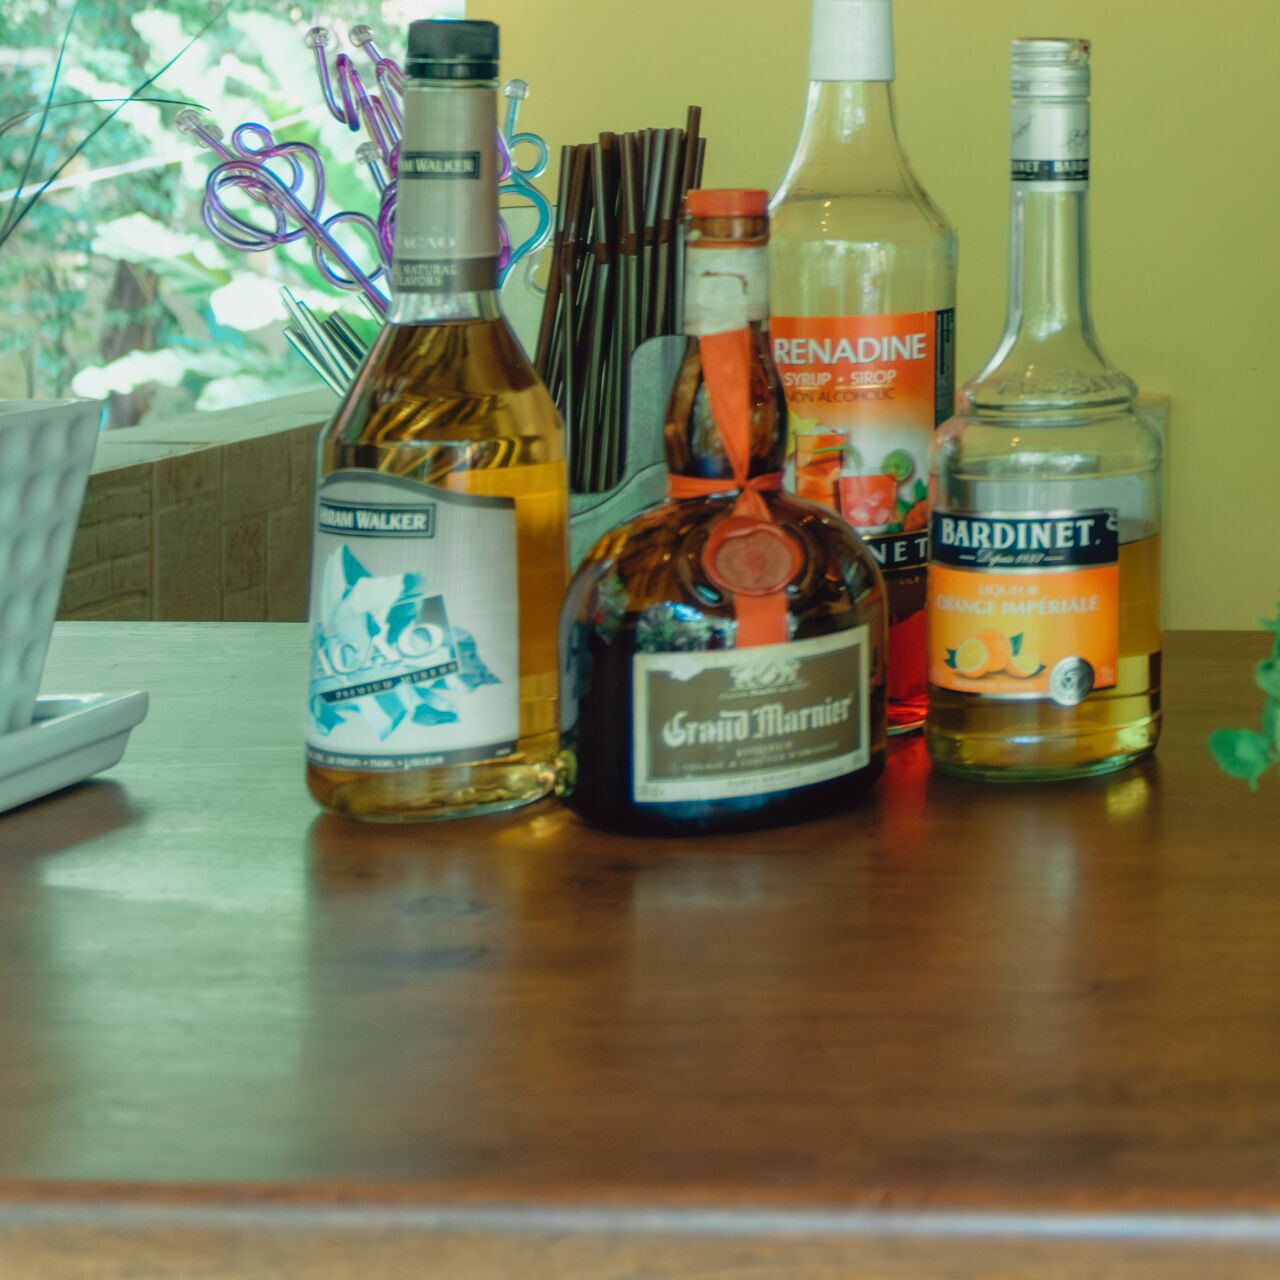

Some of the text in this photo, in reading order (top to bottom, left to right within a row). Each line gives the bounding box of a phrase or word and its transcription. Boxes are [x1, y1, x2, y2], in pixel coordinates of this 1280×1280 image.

[415, 158, 474, 173] WALKER
[773, 333, 927, 365] RENADINE
[784, 369, 897, 387] SYRUP SIROP
[819, 388, 895, 403] ALCOHOLIC
[320, 505, 428, 531] HIRAM WALKER
[941, 518, 1095, 550] BARDINET
[936, 595, 996, 616] ORANGE
[662, 695, 853, 748] Grand Marnier
